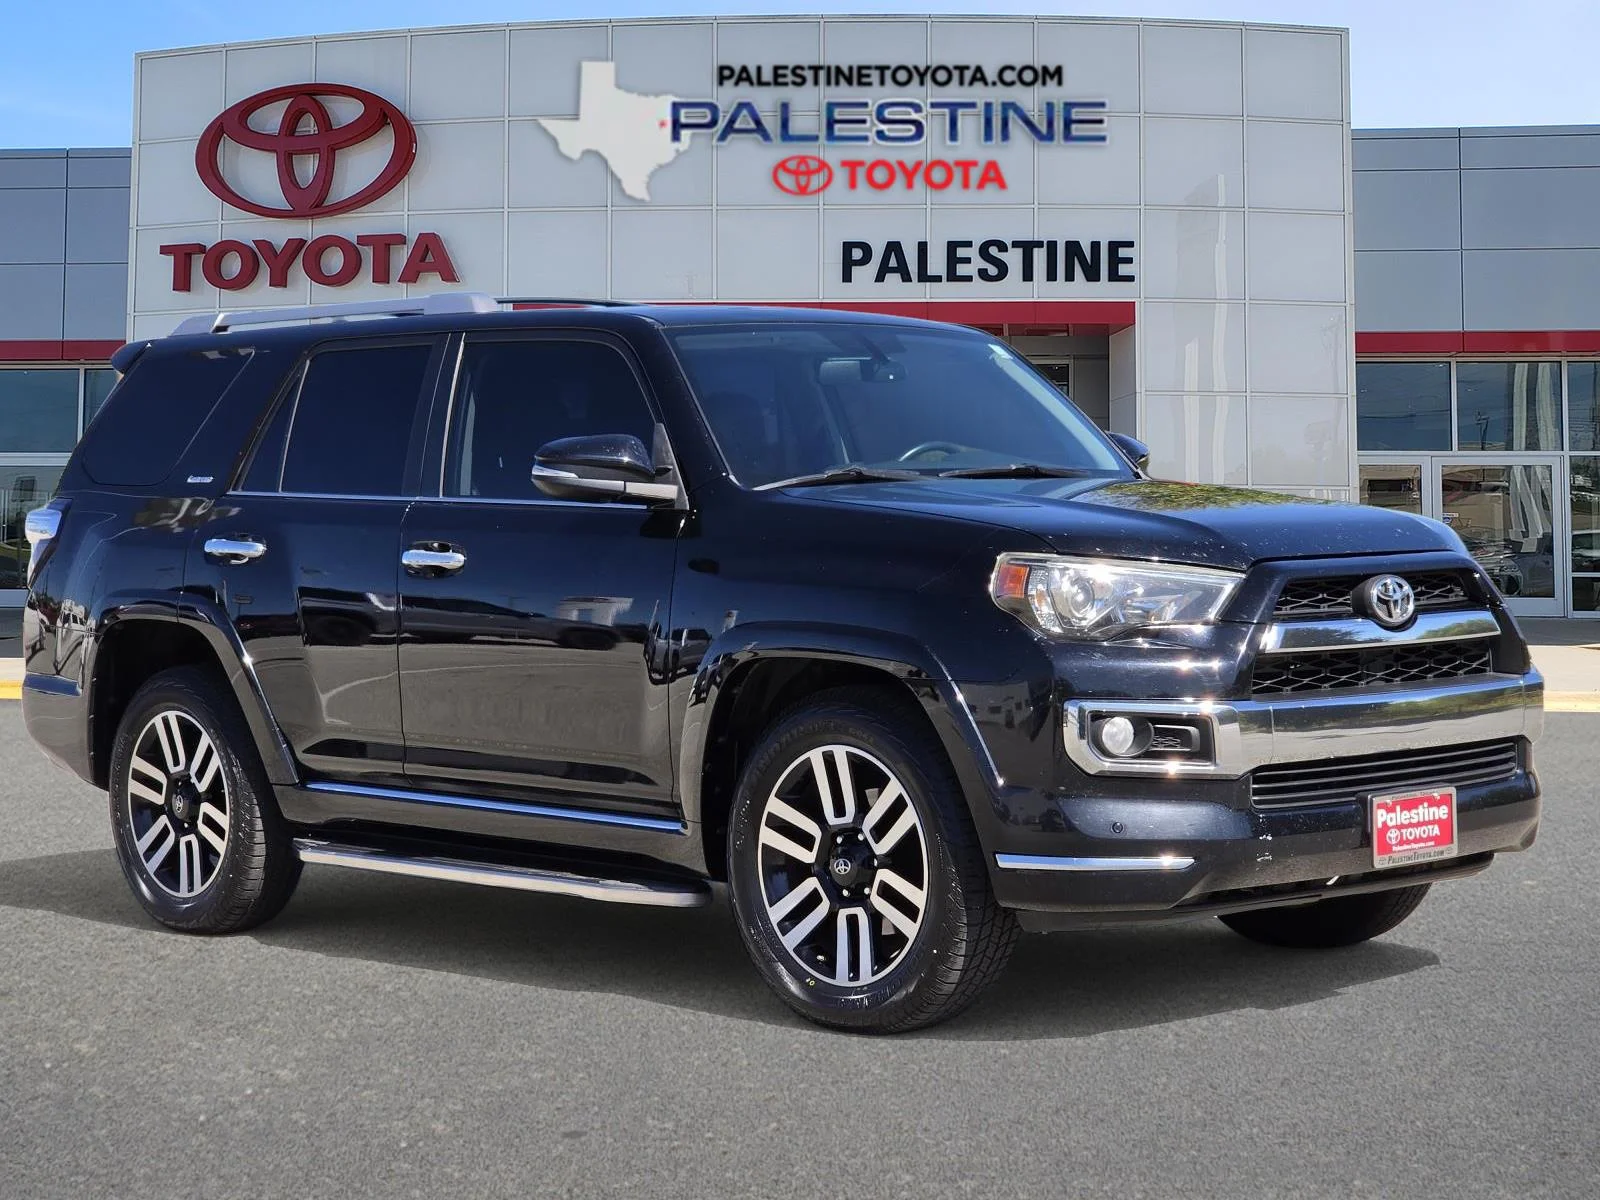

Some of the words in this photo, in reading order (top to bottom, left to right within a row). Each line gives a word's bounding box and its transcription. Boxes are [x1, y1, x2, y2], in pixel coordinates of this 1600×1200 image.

[159, 232, 461, 292] TOYOTA
[841, 239, 1136, 283] PALESTINE
[1377, 802, 1449, 828] Palestine
[1400, 825, 1440, 840] TOYOTA
